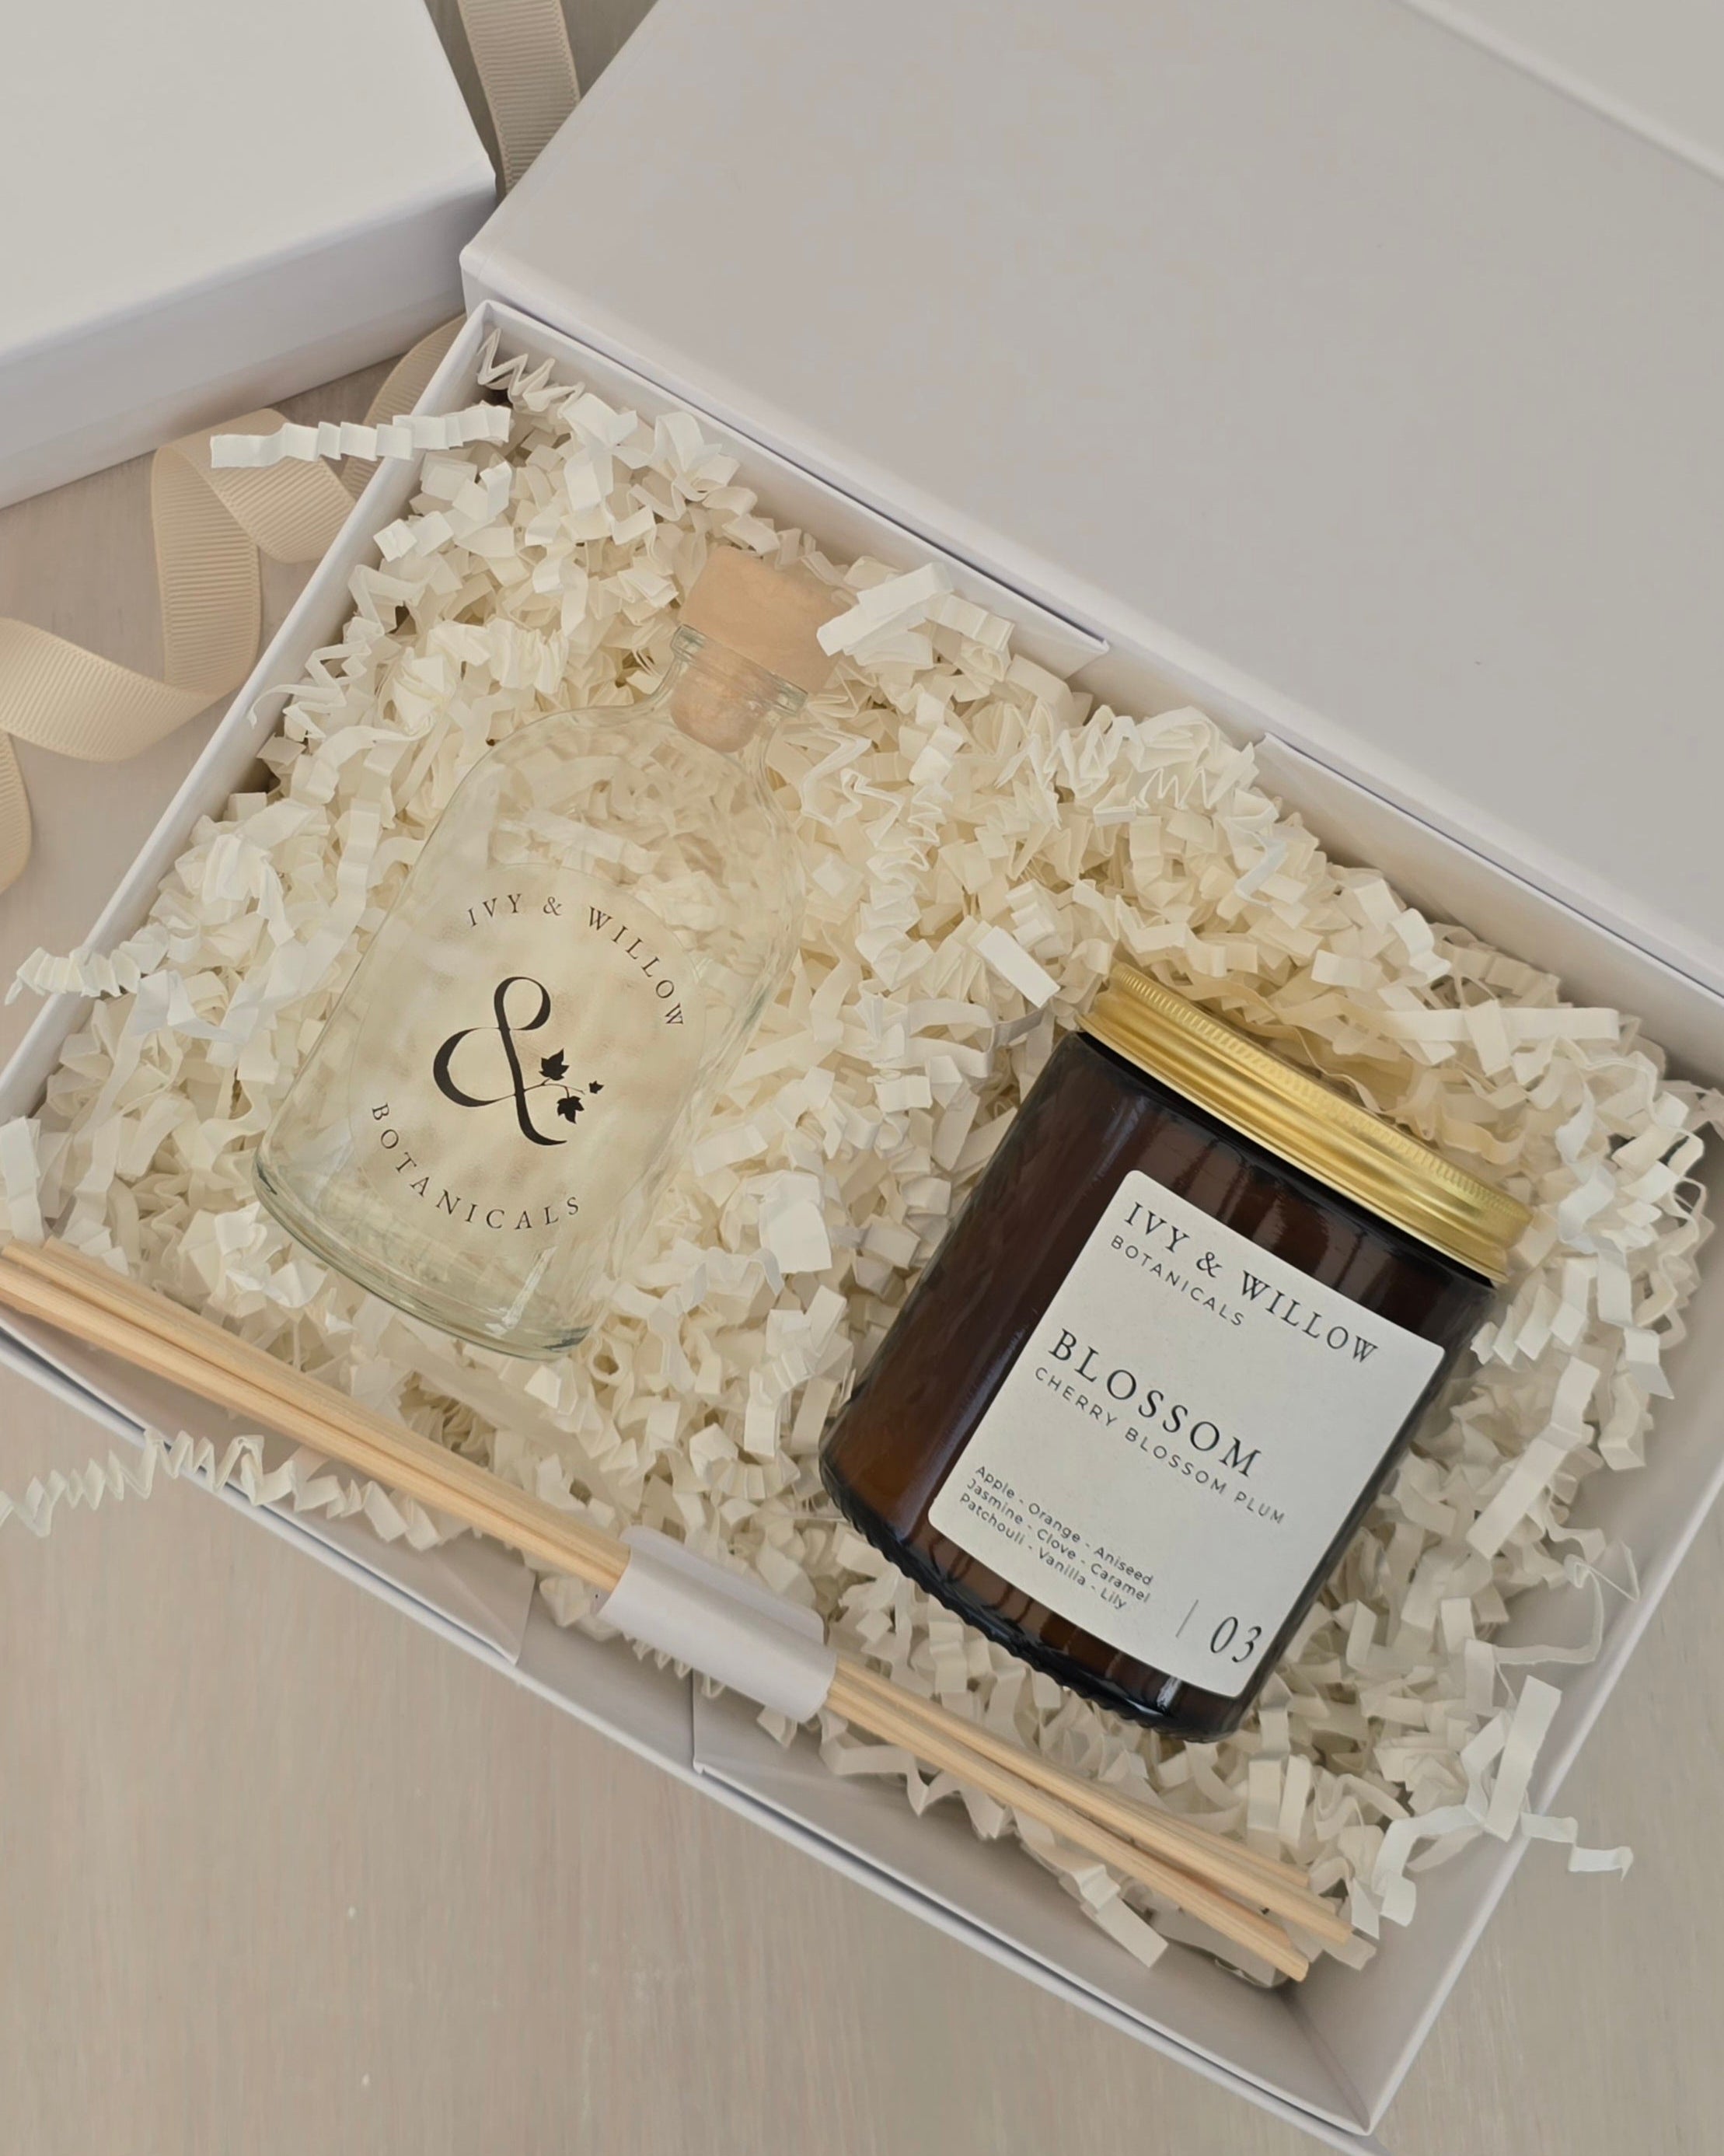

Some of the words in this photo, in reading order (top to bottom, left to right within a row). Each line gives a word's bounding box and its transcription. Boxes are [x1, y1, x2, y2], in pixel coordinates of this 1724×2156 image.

[468, 893, 522, 927] IVY
[543, 896, 563, 916] &
[588, 906, 684, 1027] WILLOW
[371, 1102, 580, 1230] BOTANICALS
[1110, 1235, 1244, 1326] BOTANICALS
[1124, 1201, 1190, 1253] IVY
[1195, 1251, 1223, 1278] &
[1241, 1270, 1378, 1363] WILLOW
[1035, 1367, 1118, 1427] CHERRY
[1125, 1427, 1227, 1494] BLOSSOM
[1234, 1490, 1285, 1524] PLUM
[1048, 1328, 1262, 1476] BLOSSOM
[959, 1493, 1026, 1546] Patchouli
[1038, 1547, 1086, 1586] Vanilla
[1100, 1588, 1127, 1609] Lily
[967, 1478, 1024, 1525] Jasmine
[1037, 1529, 1076, 1560] Clove
[1090, 1563, 1151, 1603] Caramel
[975, 1466, 1015, 1499] Apple
[1028, 1502, 1080, 1543] Orange
[1094, 1546, 1154, 1585] Aniseed
[1210, 1616, 1262, 1662] 03
